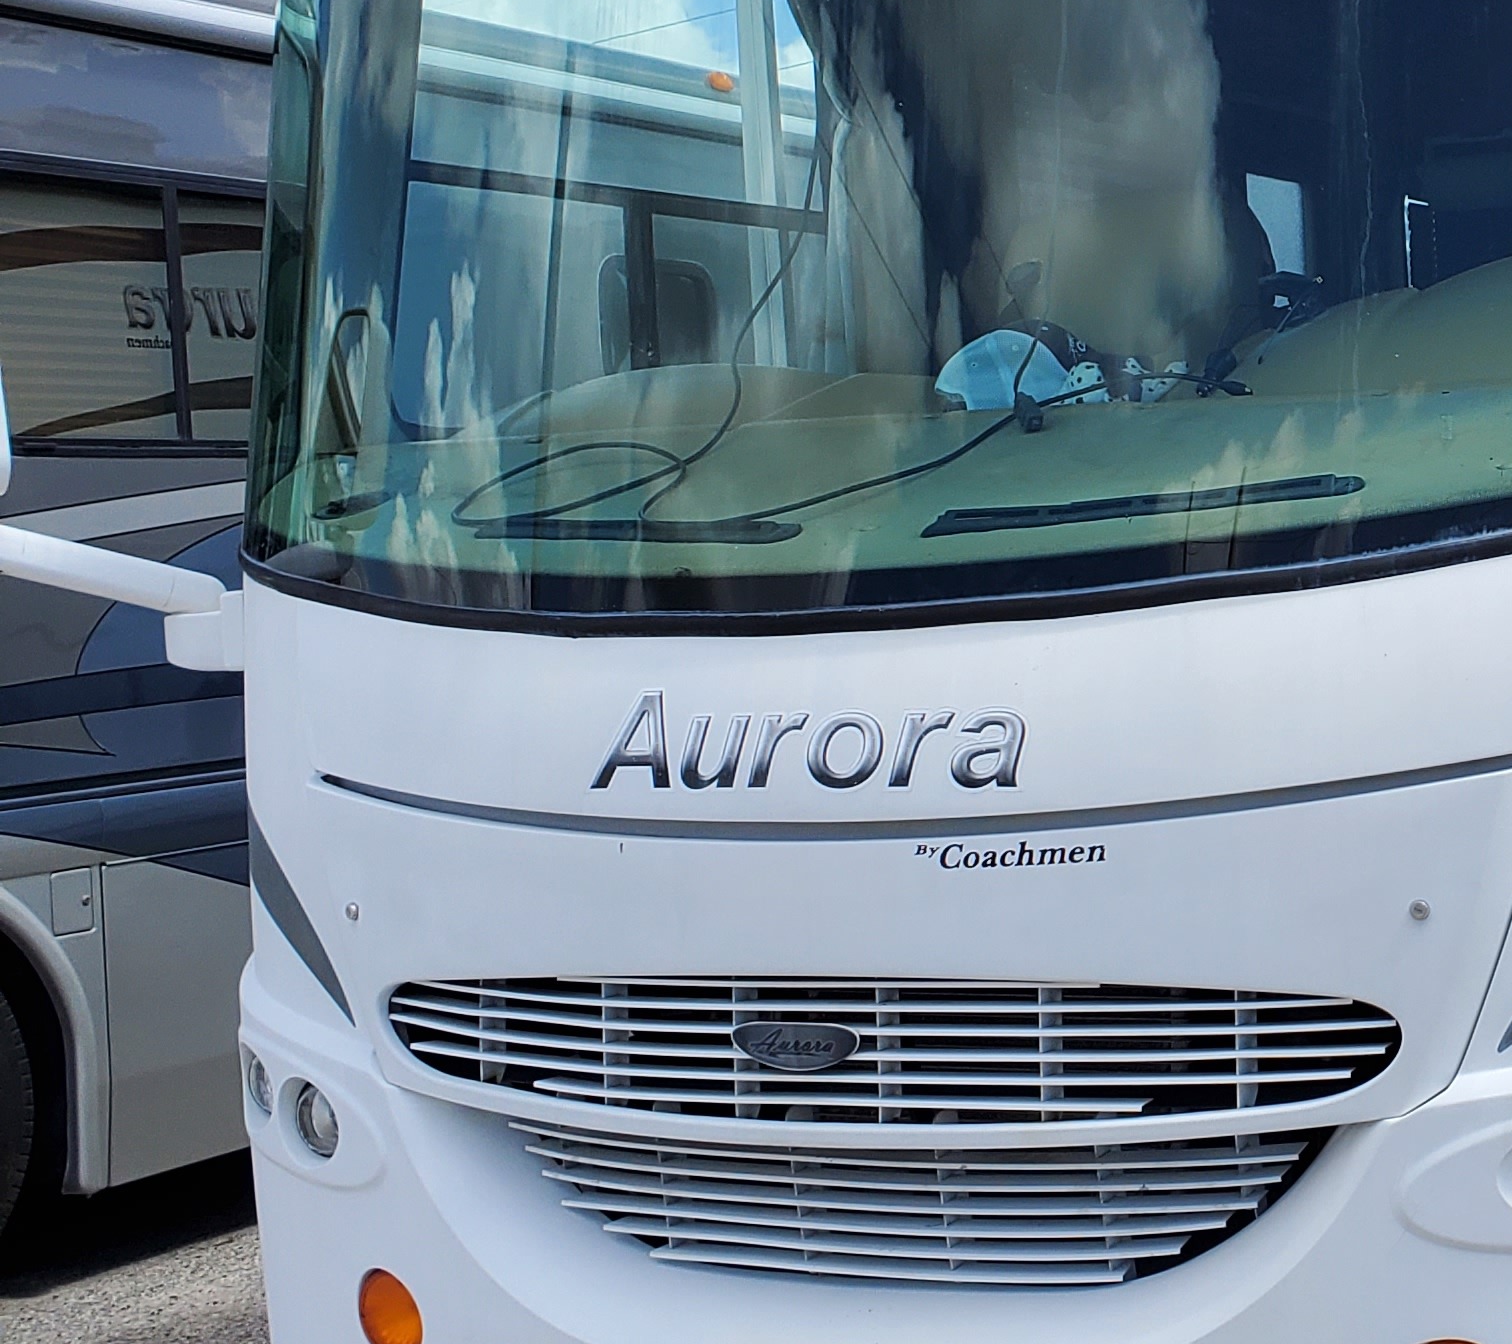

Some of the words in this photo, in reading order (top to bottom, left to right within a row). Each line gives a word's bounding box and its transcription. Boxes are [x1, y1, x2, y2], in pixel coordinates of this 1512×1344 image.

[588, 687, 1029, 791] Aurora
[914, 844, 940, 858] By
[939, 840, 1107, 869] Coachmen
[750, 1027, 836, 1055] Aurora
